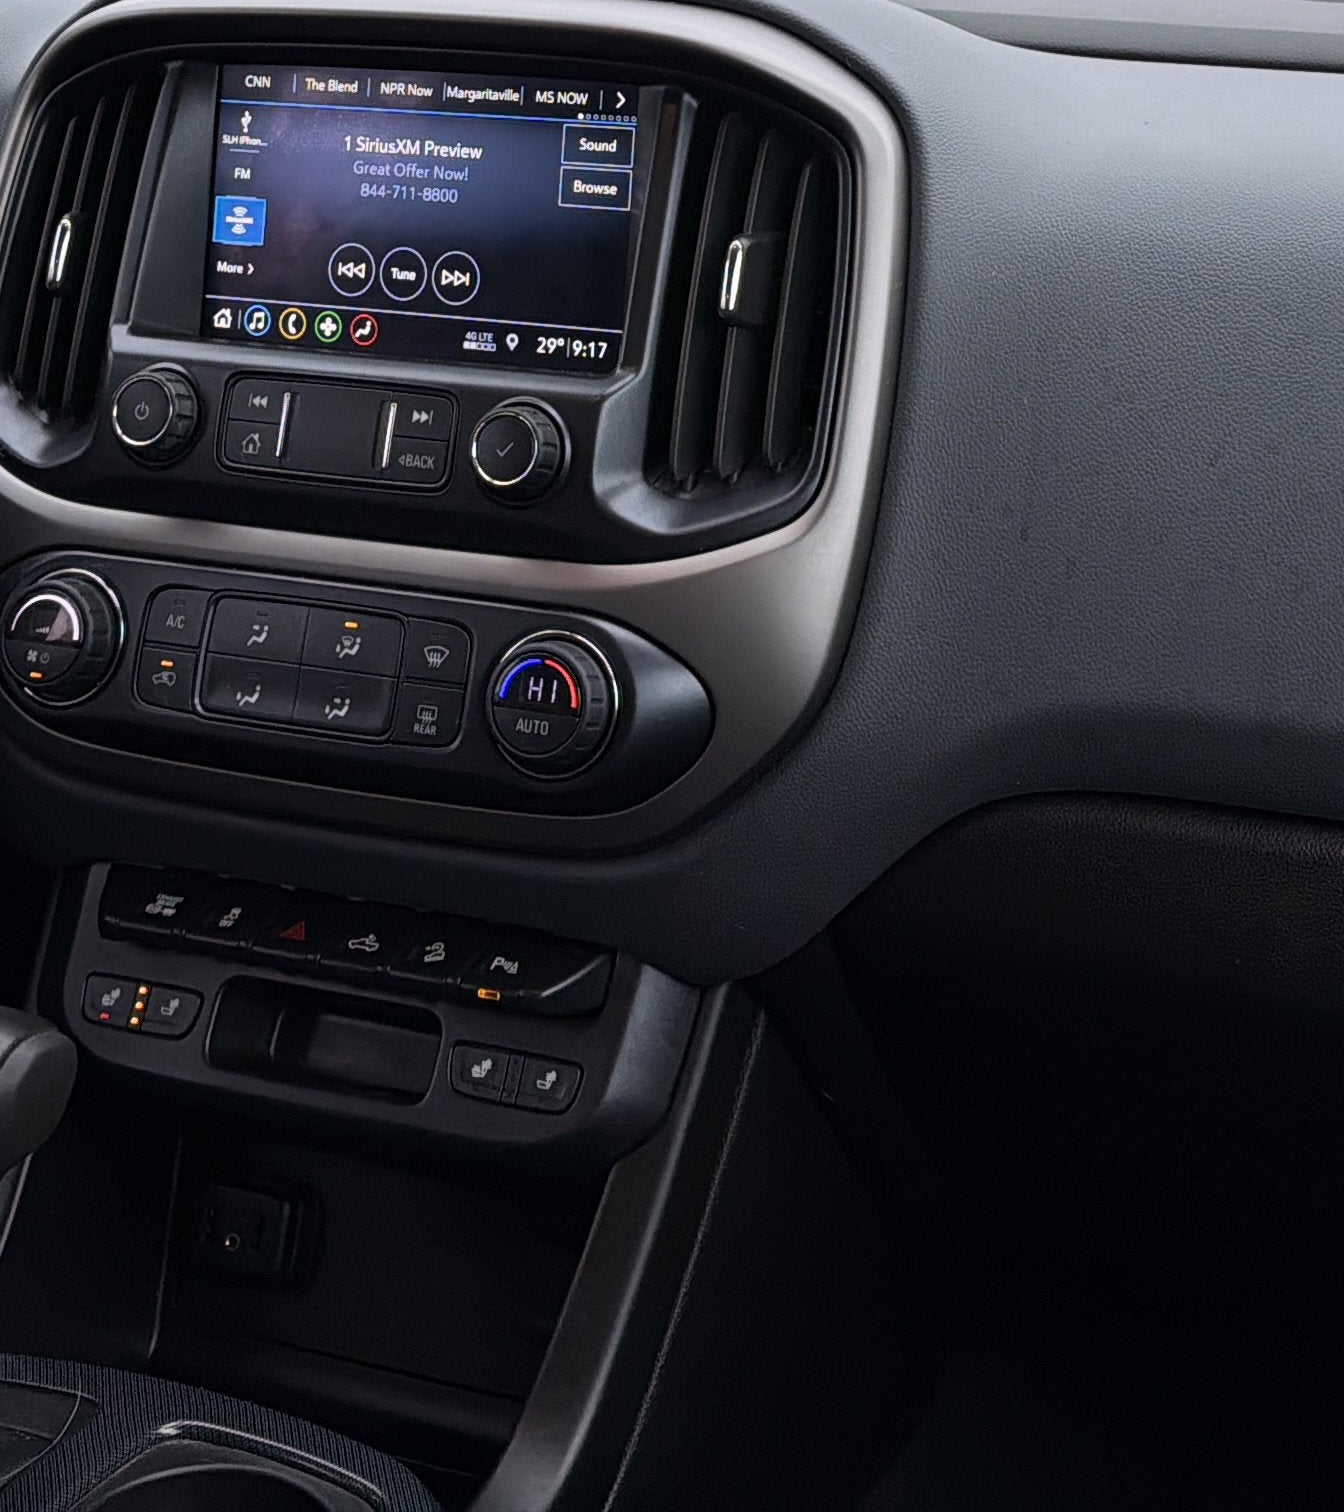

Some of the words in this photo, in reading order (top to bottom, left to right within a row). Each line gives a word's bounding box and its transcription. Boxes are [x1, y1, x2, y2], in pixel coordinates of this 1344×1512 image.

[244, 74, 271, 88] CNN
[305, 77, 326, 91] The
[327, 78, 359, 93] Blend
[380, 81, 406, 96] NPR
[407, 84, 433, 97] Now
[447, 85, 520, 103] Margaritaville
[535, 90, 555, 103] MS
[557, 91, 589, 105] NOW
[344, 135, 352, 152] 1
[355, 137, 421, 156] SiriusXM
[424, 140, 483, 160] Preview
[579, 137, 617, 153] Sound
[234, 167, 251, 180] FM
[353, 160, 391, 177] Great
[394, 162, 431, 179] Offer
[433, 165, 469, 182] Now!
[360, 182, 458, 203] 844-711-8800
[573, 179, 618, 196] Browse
[216, 260, 244, 275] More
[391, 267, 416, 281] Tune
[465, 331, 477, 340] 4G
[478, 332, 494, 342] LTE
[572, 339, 608, 358] 9:17
[405, 453, 435, 471] BACK
[166, 613, 186, 629] A/C
[413, 723, 437, 736] REAR
[515, 717, 549, 736] AUTO
